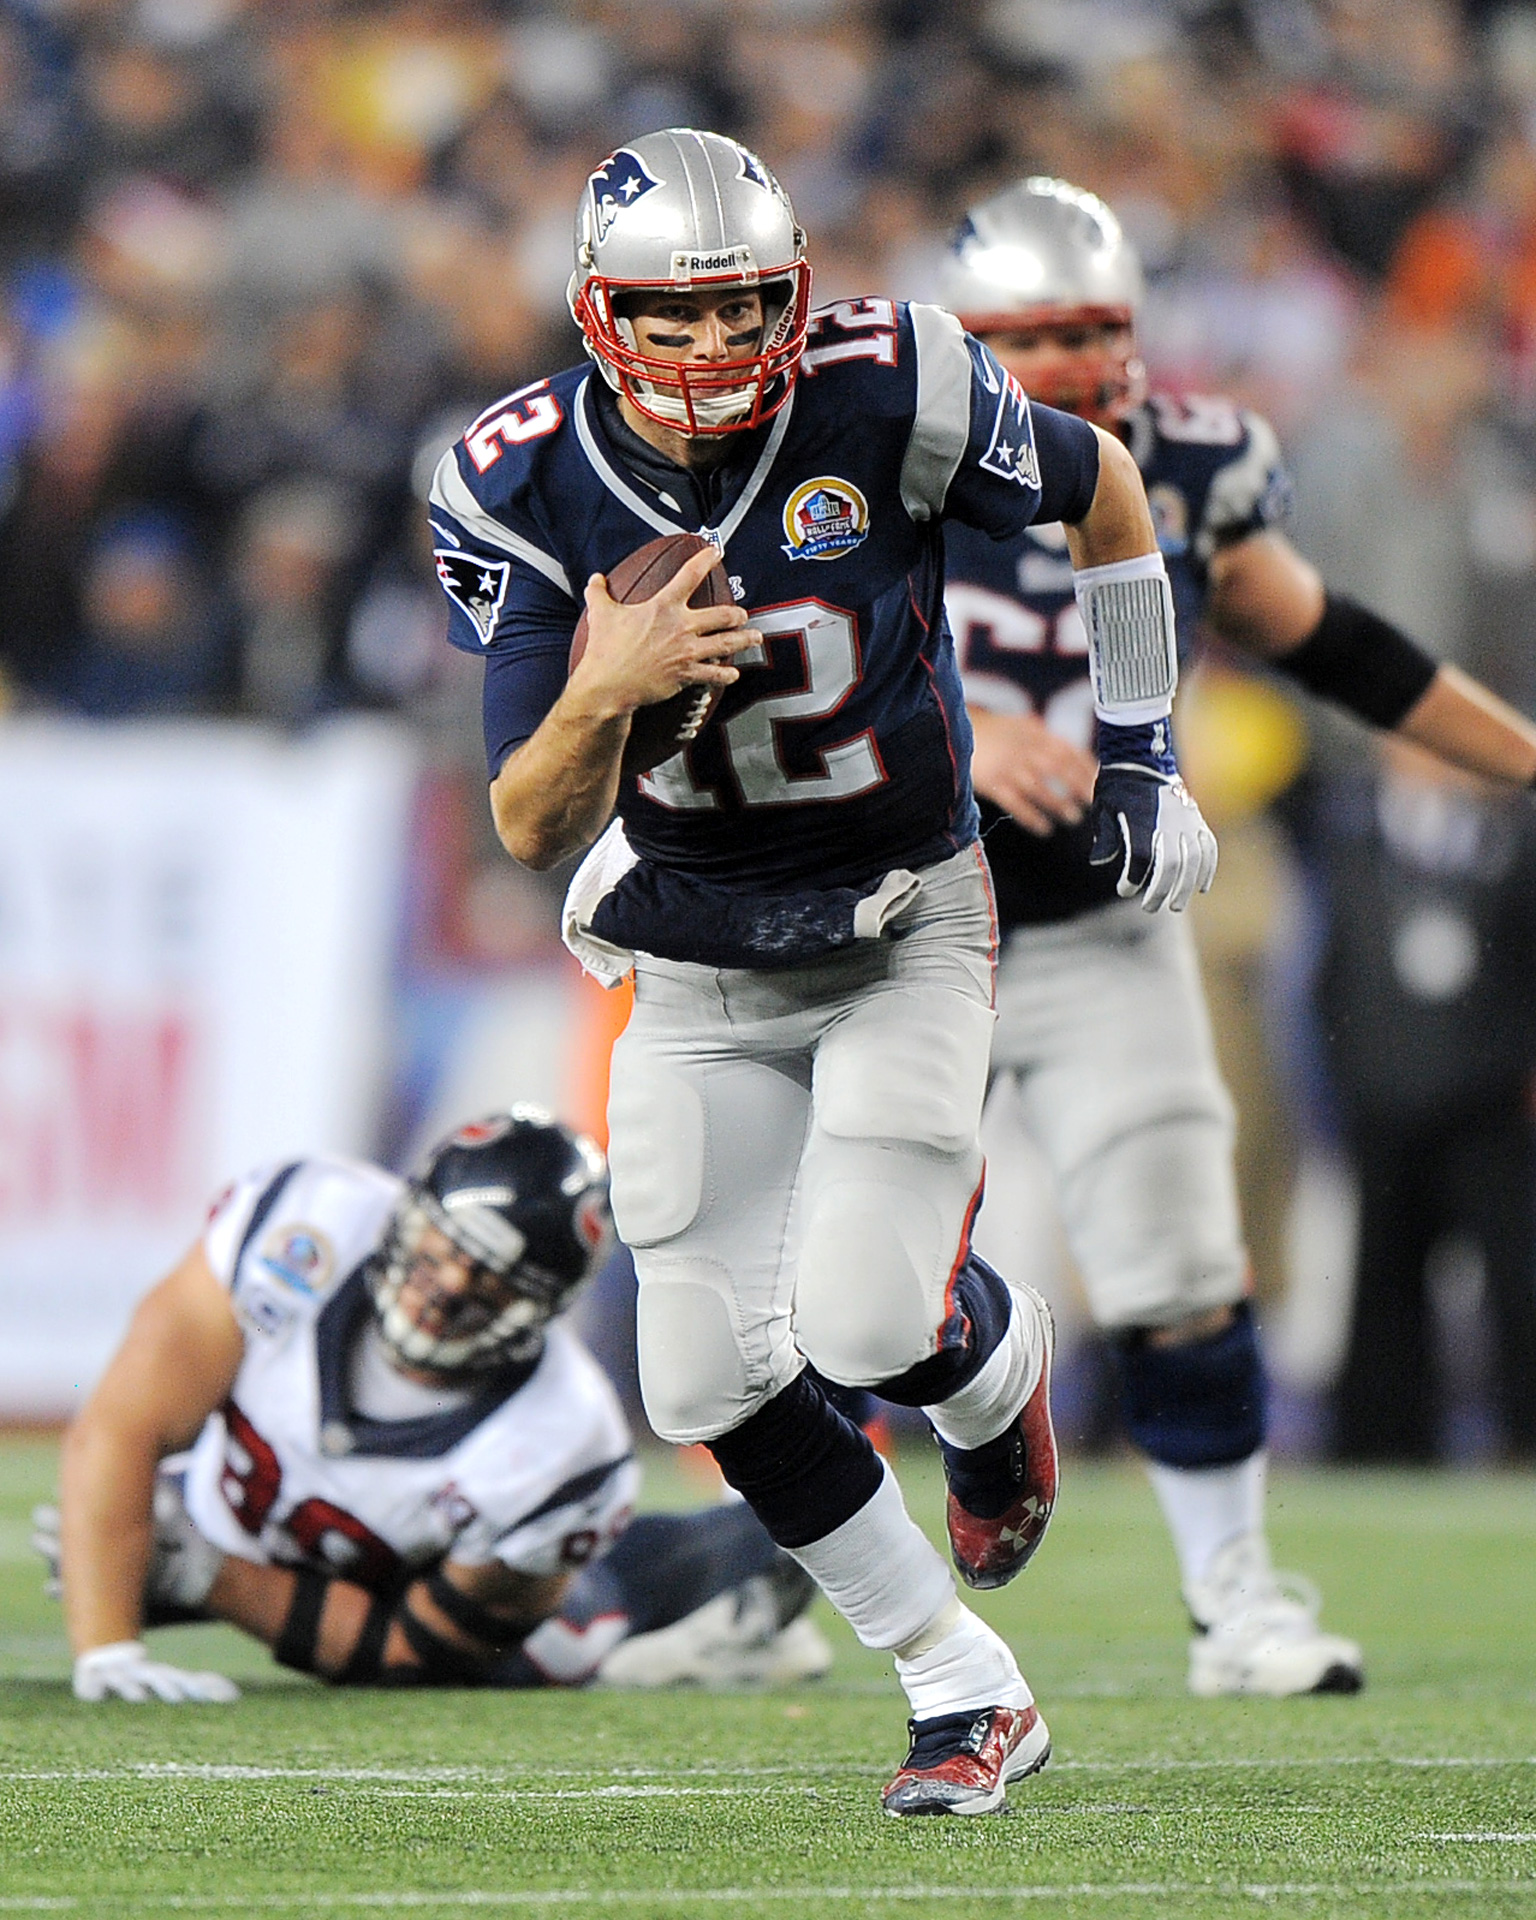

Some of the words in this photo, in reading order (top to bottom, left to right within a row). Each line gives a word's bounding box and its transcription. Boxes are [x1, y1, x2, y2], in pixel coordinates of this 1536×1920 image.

[690, 252, 736, 270] Riddell
[801, 295, 898, 378] 12
[463, 378, 564, 476] 12
[829, 538, 857, 547] YEARS
